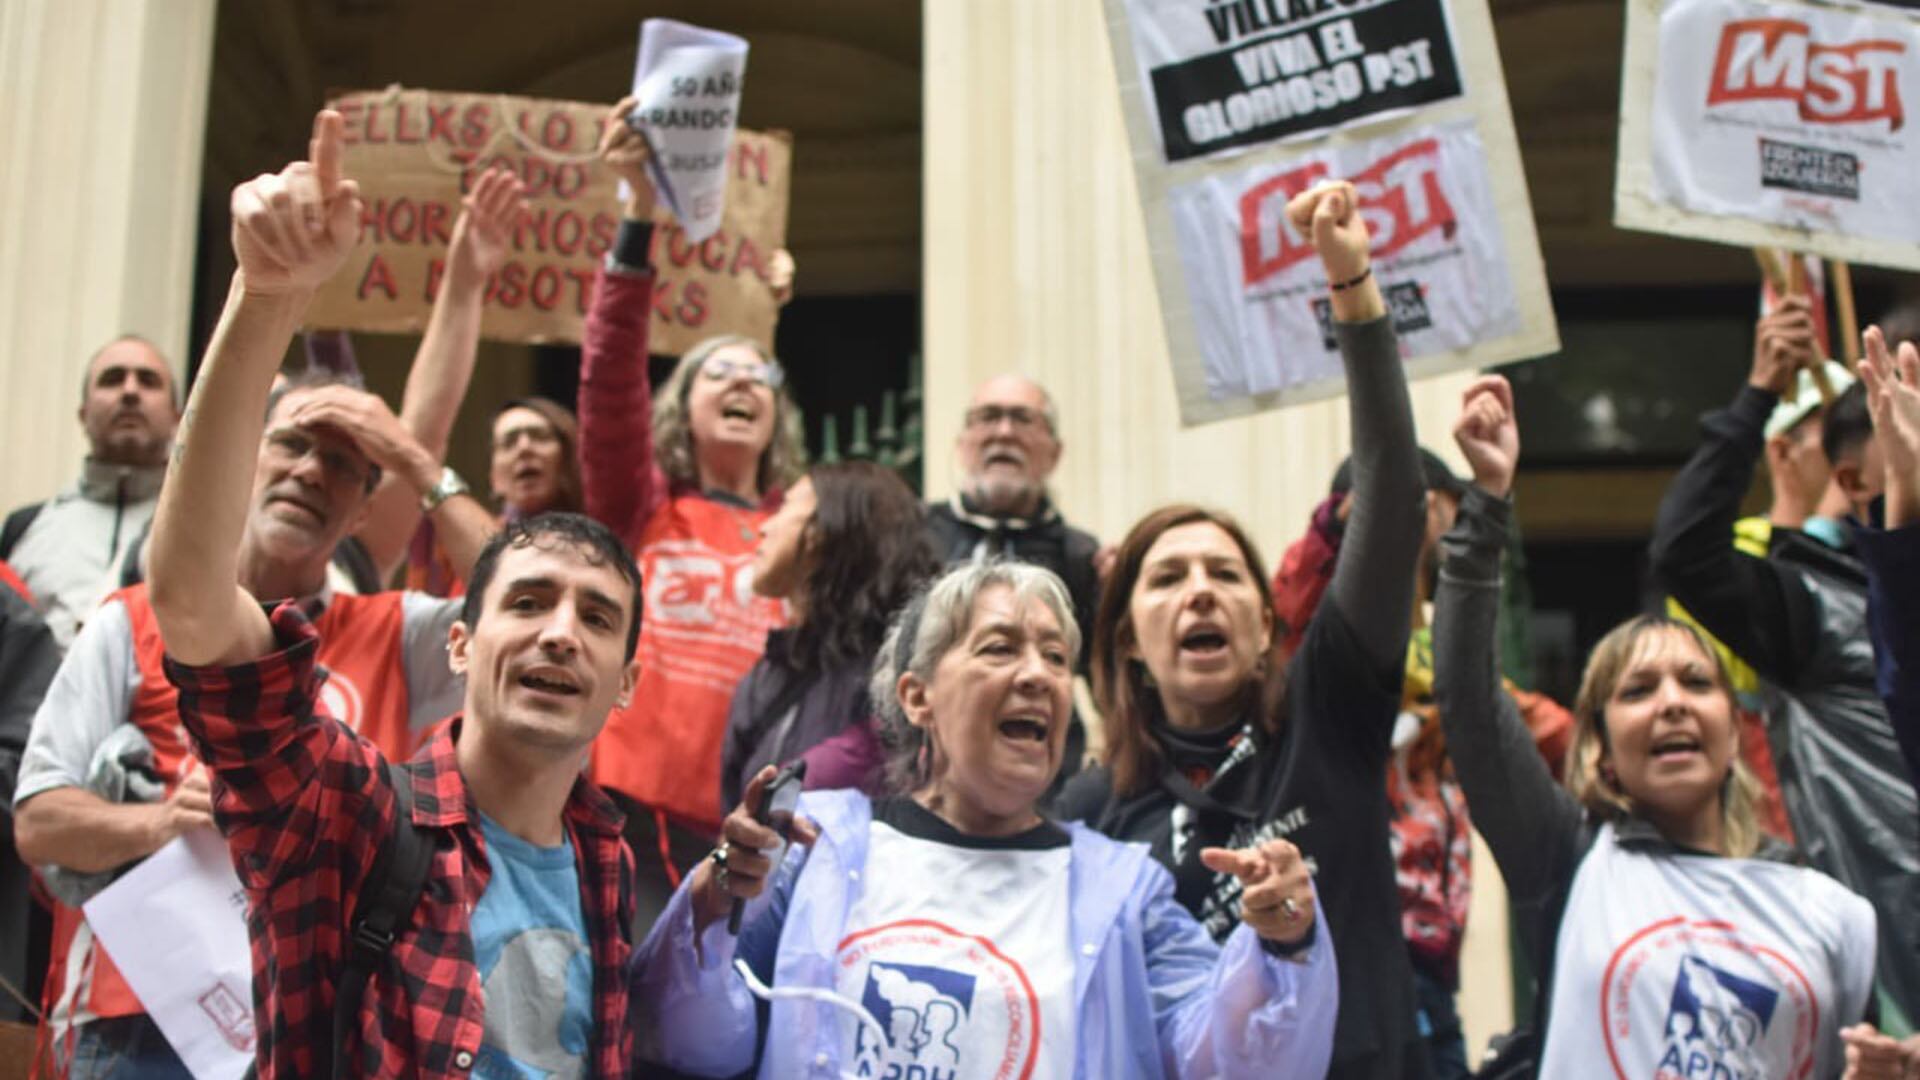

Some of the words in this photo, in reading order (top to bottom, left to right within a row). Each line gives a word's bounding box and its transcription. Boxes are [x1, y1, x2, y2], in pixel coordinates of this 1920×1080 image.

[1233, 32, 1319, 86] VIVA
[1319, 18, 1364, 63] EL
[1722, 26, 1906, 120] MST
[1183, 61, 1363, 144] GLORIOSO
[1364, 39, 1434, 93] PST
[339, 103, 490, 147] ELLXS
[514, 207, 618, 262] NOS
[358, 255, 398, 301] A
